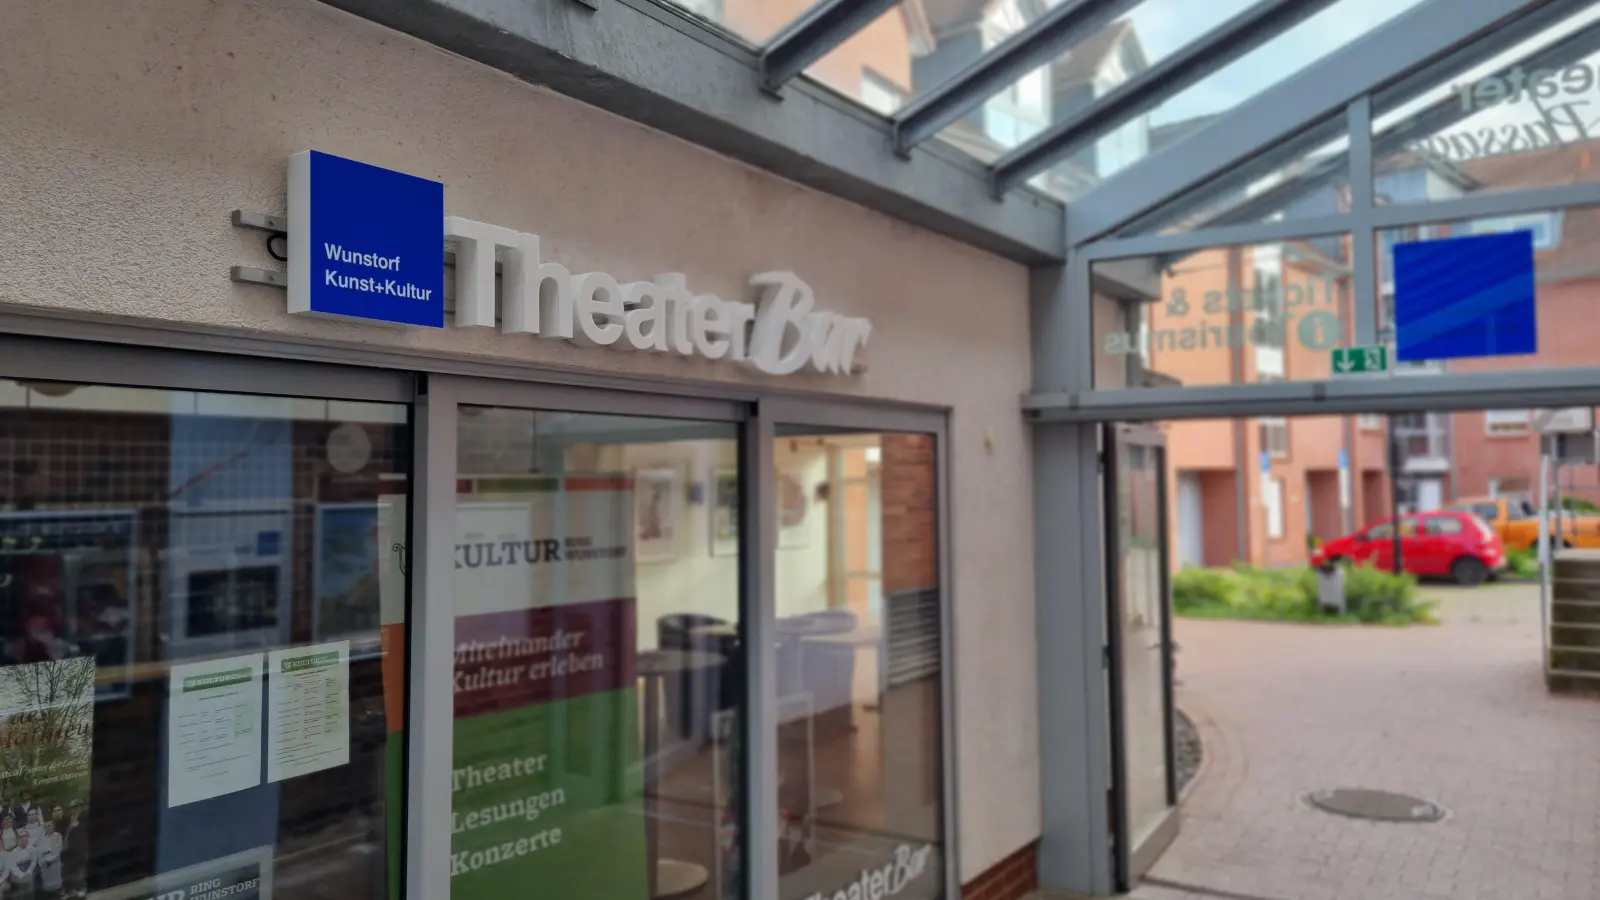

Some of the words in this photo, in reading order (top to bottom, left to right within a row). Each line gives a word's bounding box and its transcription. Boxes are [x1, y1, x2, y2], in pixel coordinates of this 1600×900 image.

[324, 241, 401, 271] Wunstorf
[323, 269, 433, 302] Kunst+Kultur
[528, 652, 604, 681] erleben
[452, 754, 548, 792] Theater
[451, 788, 566, 835] Lesungen
[451, 827, 562, 876] Konzerte
[190, 878, 221, 896] RING
